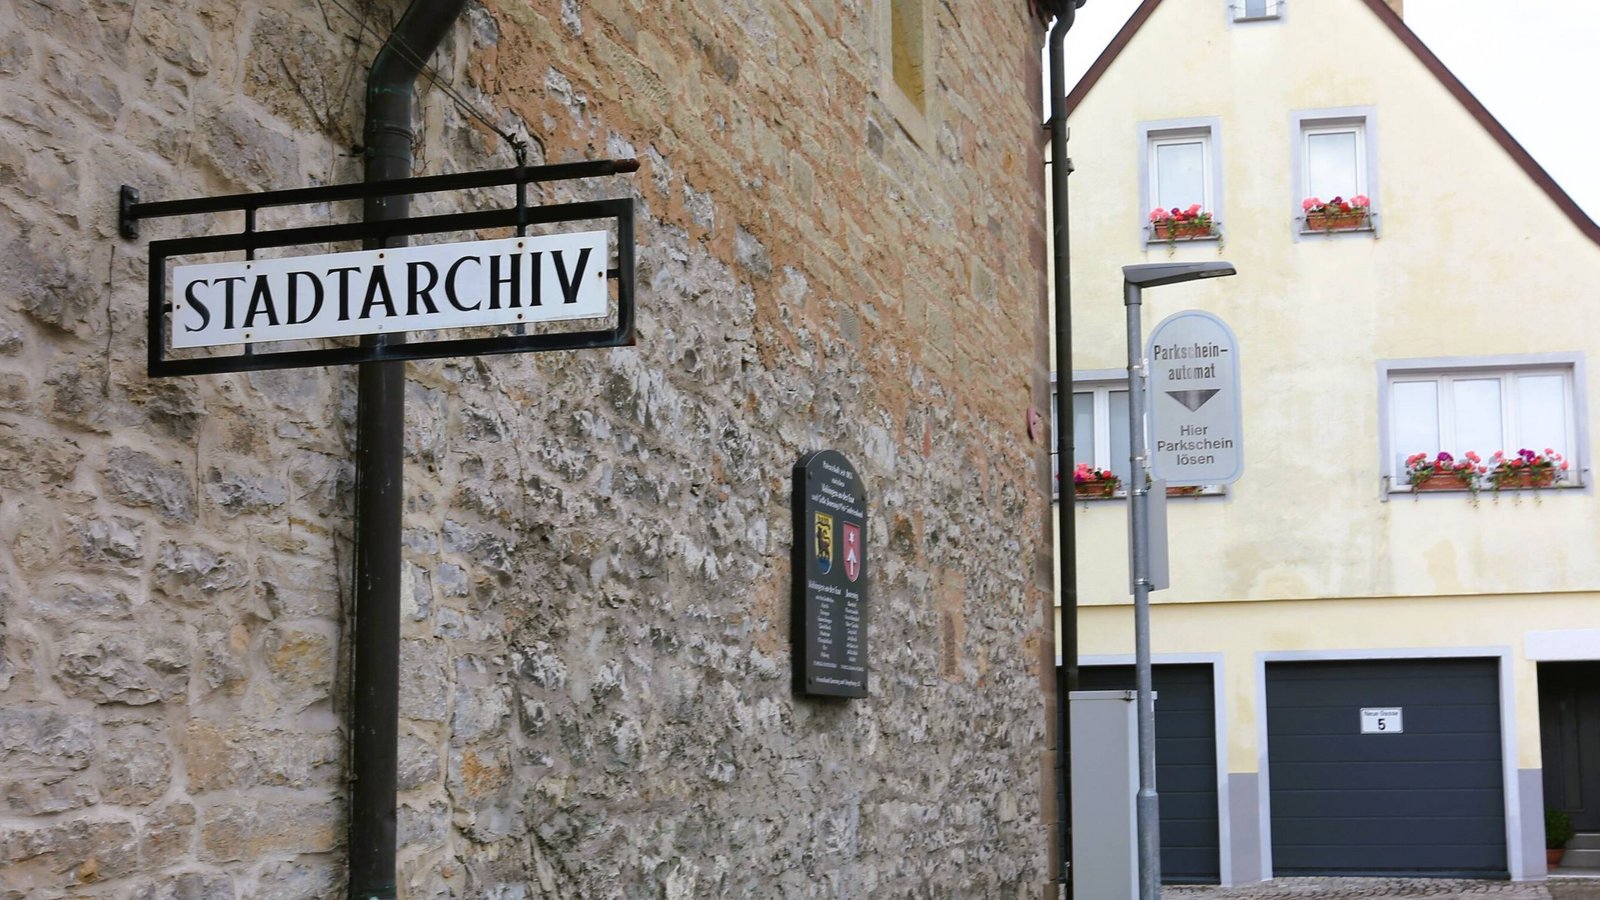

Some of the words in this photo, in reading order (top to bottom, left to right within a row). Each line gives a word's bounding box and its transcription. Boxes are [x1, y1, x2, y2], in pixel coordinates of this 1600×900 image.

[184, 247, 593, 333] STADTARCHIV
[1154, 342, 1228, 360] Parkschein-
[1168, 363, 1216, 380] automat
[1180, 425, 1208, 436] Hier
[1157, 438, 1233, 452] Parkschein
[1176, 453, 1215, 465] lösen
[1378, 718, 1386, 731] 5
